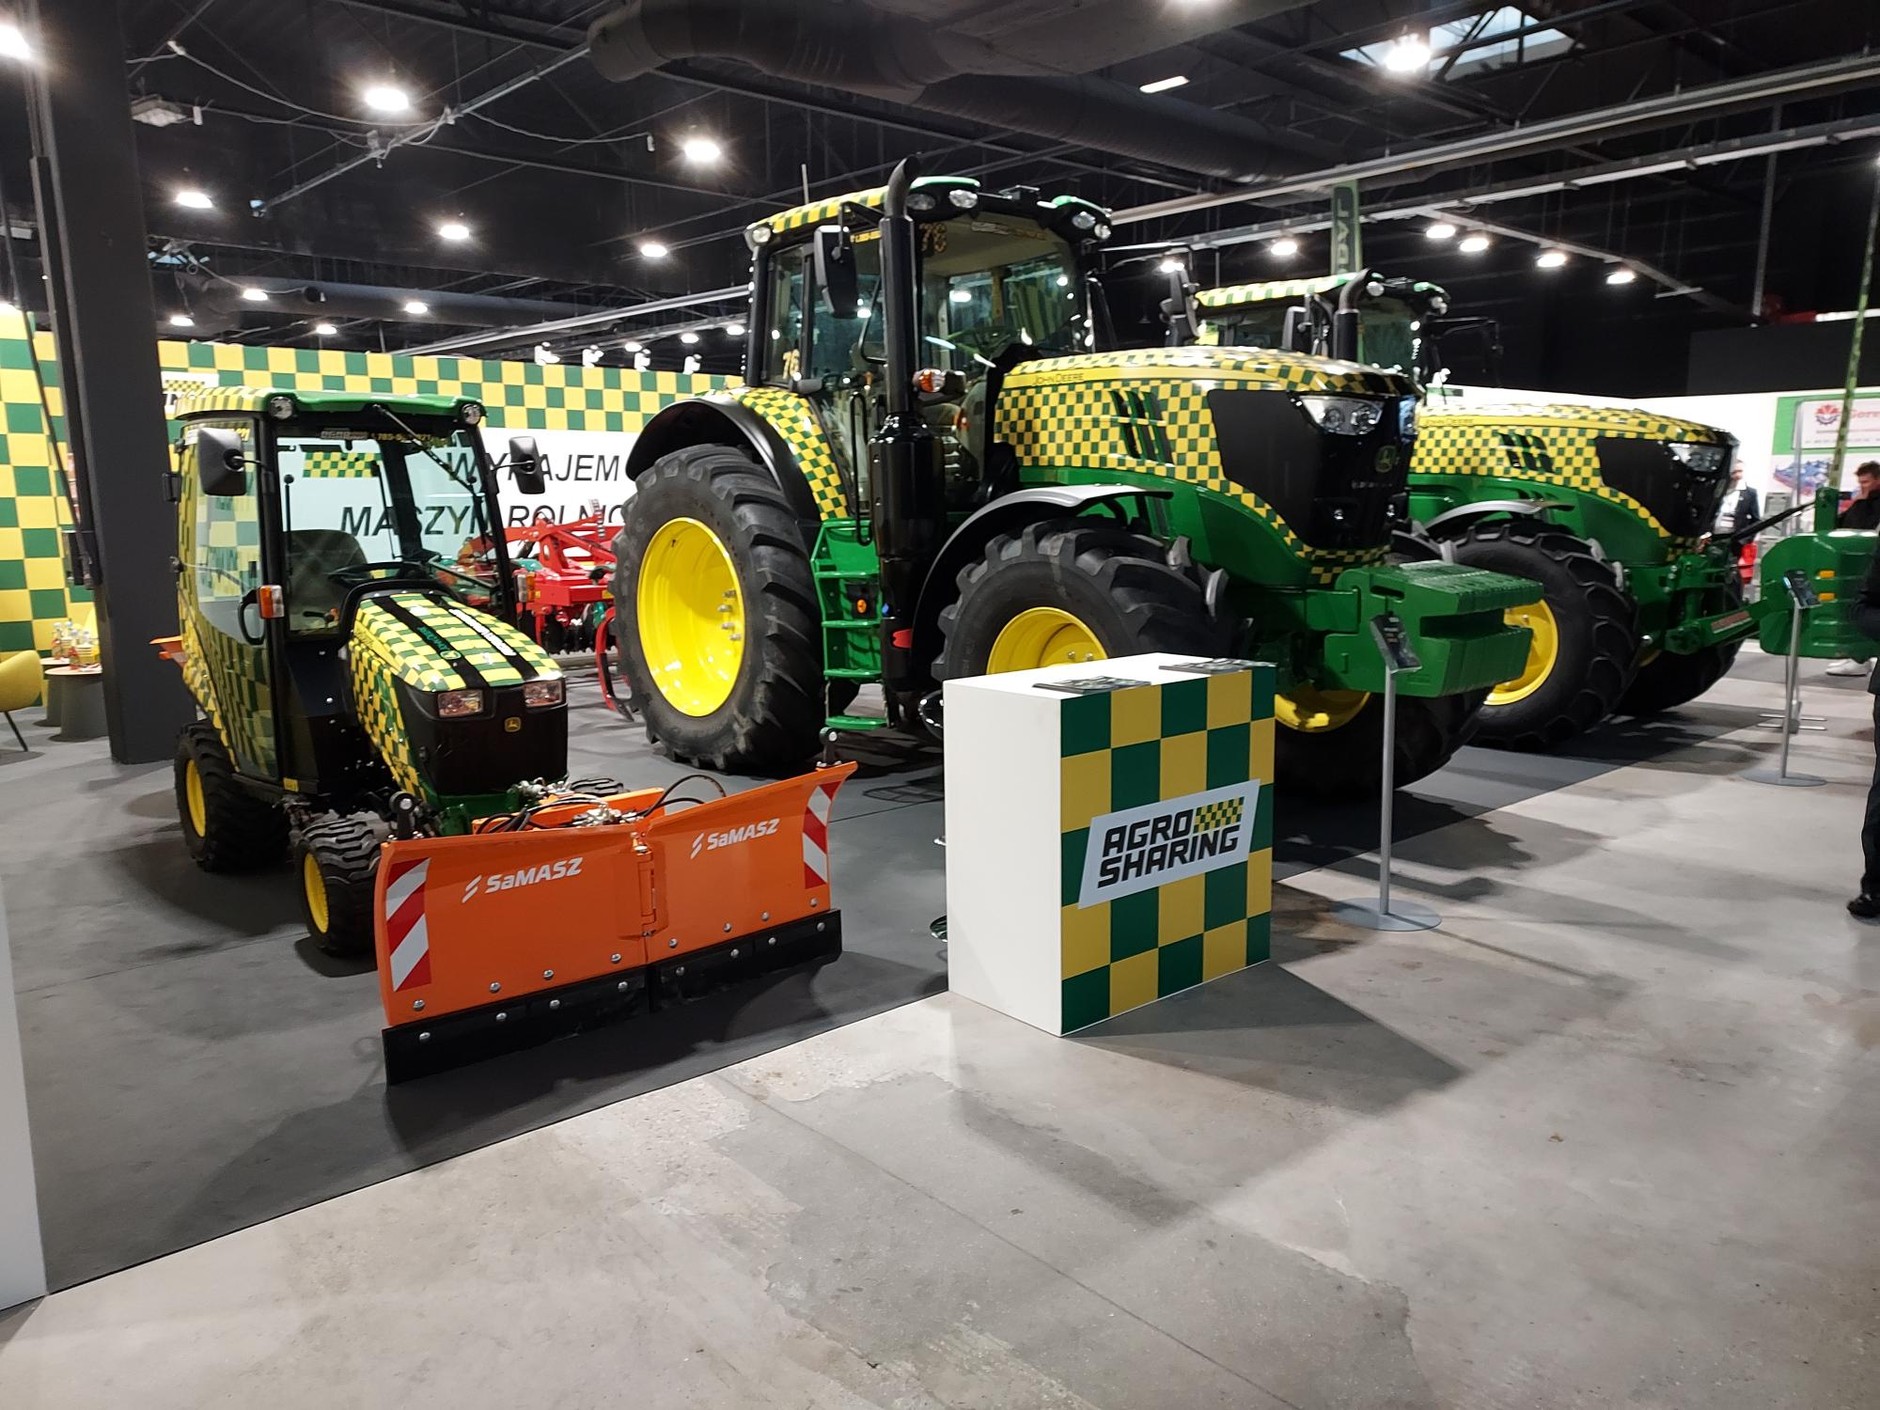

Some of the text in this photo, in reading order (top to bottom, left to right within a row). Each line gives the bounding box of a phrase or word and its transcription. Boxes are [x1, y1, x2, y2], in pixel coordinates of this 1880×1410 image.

[1055, 372, 1085, 384] DEERE
[446, 452, 620, 482] WYAJEM
[340, 505, 485, 537] MAZY
[707, 817, 781, 851] SaMASZ
[1102, 808, 1195, 858] AGRO
[1097, 825, 1241, 889] SHARING
[485, 857, 583, 894] SaMASZ
